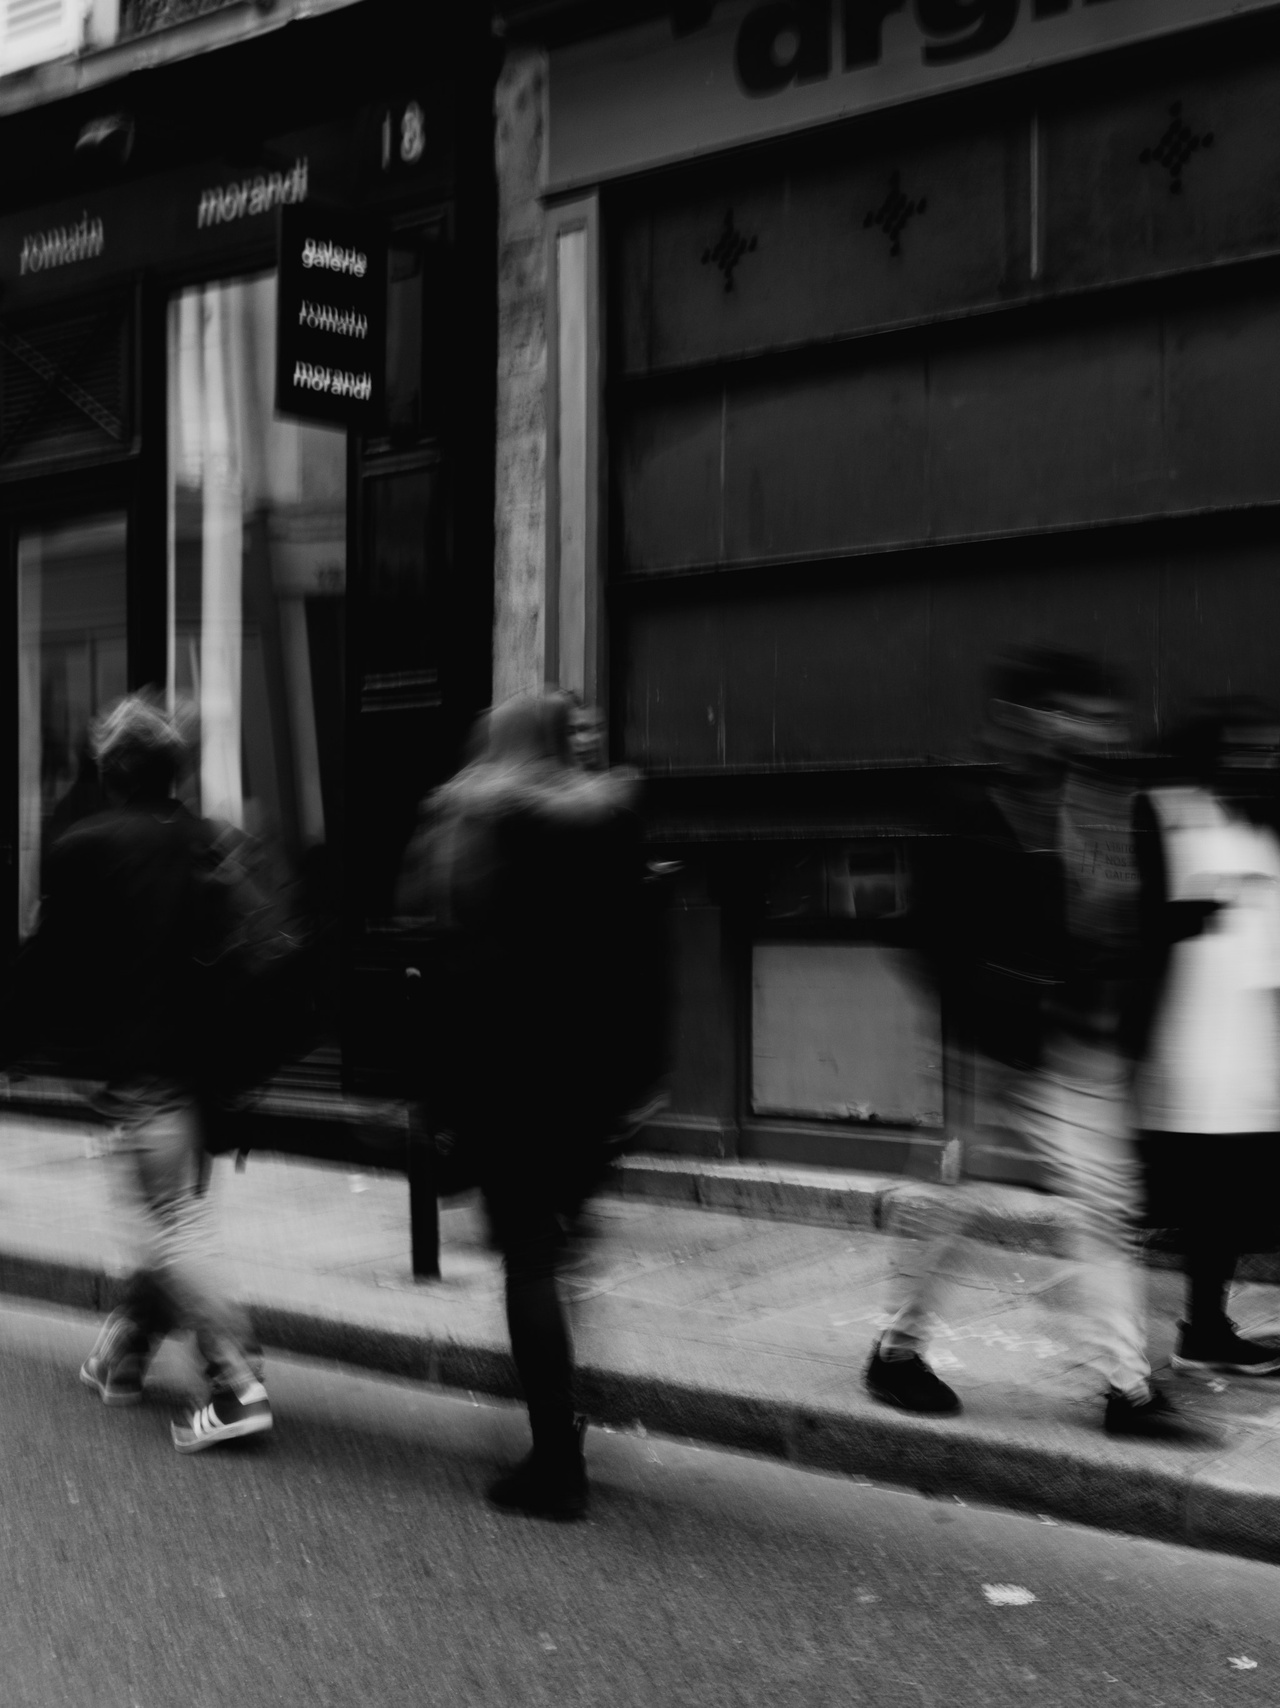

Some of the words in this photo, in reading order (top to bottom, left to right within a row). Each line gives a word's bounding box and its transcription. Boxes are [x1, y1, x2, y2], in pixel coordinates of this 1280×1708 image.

[380, 99, 426, 173] 18
[19, 208, 105, 276] romain
[196, 155, 309, 230] morandi
[301, 237, 368, 278] galerie
[299, 299, 368, 340] romain
[292, 360, 373, 401] morandi
